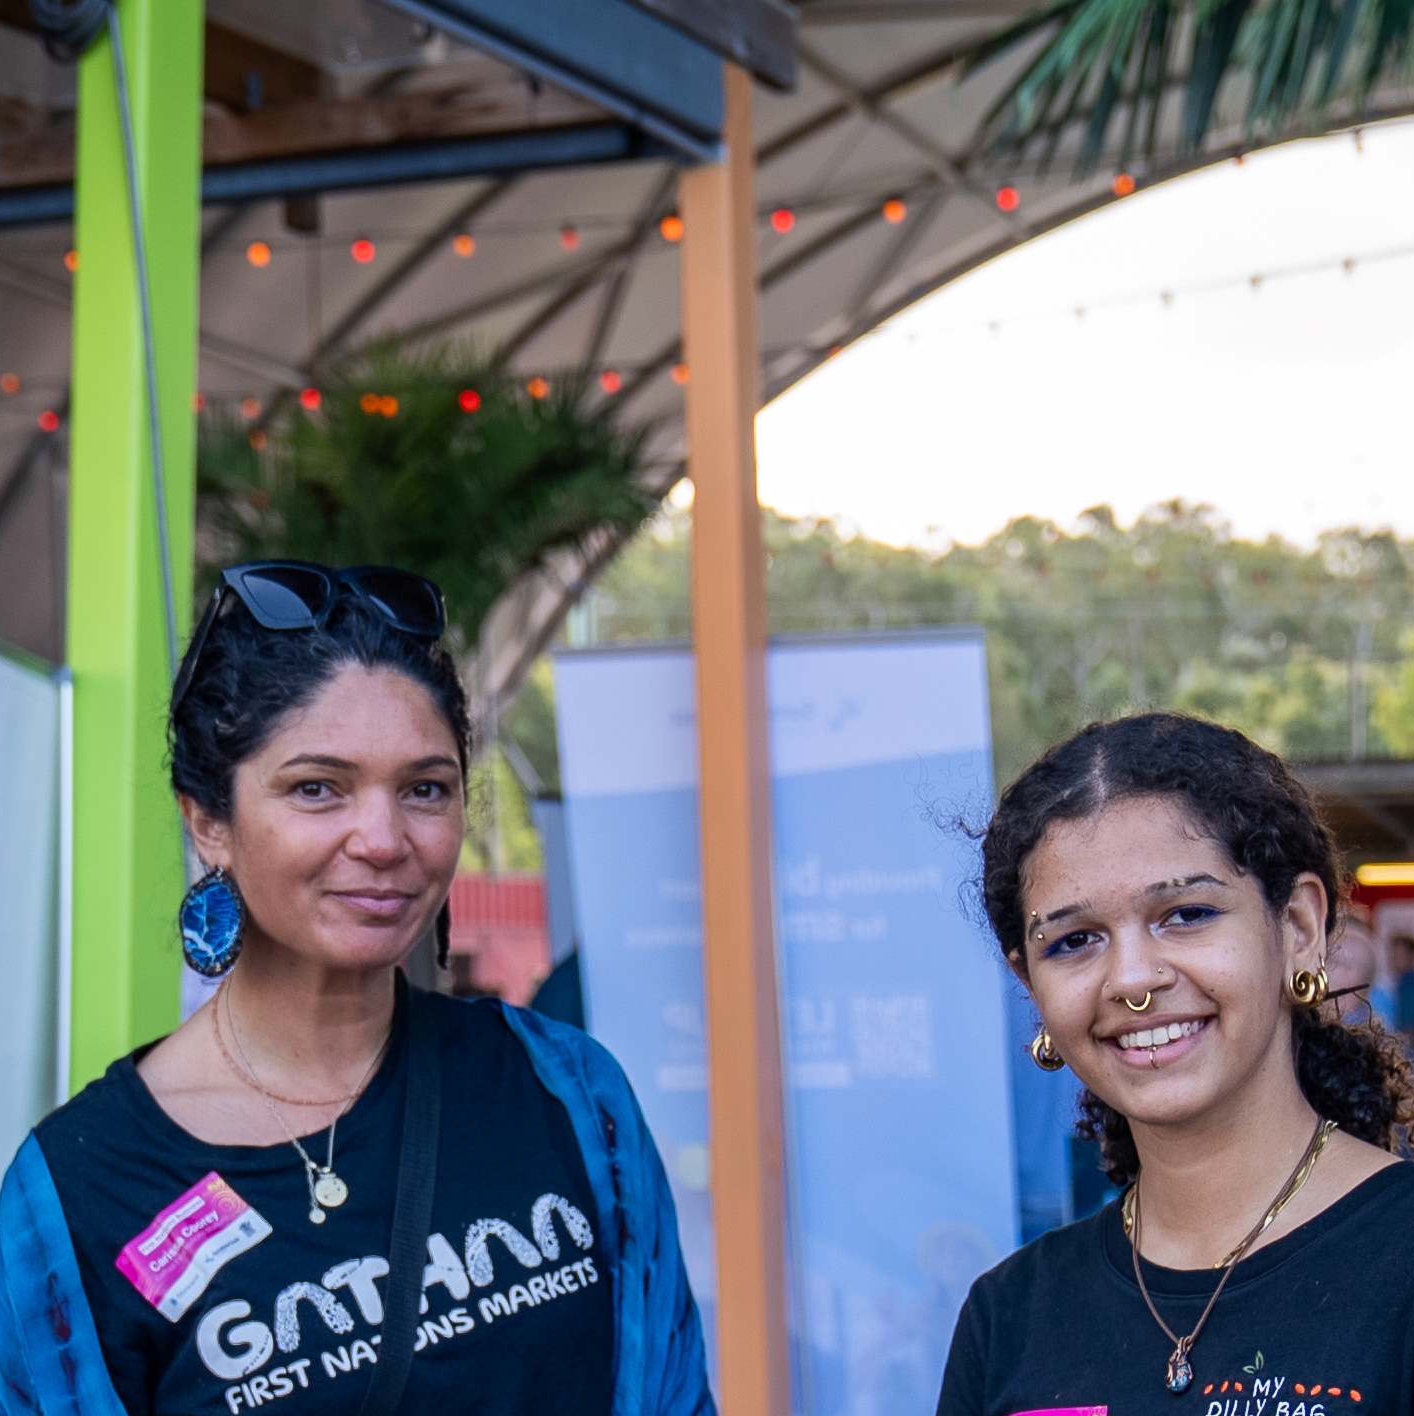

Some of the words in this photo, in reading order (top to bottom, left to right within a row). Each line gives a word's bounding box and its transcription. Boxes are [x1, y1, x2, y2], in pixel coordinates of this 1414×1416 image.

[225, 1358, 311, 1415] FIRST
[321, 1308, 474, 1378] NAONS
[478, 1256, 599, 1324] MARKETS
[1252, 1376, 1286, 1399] MY
